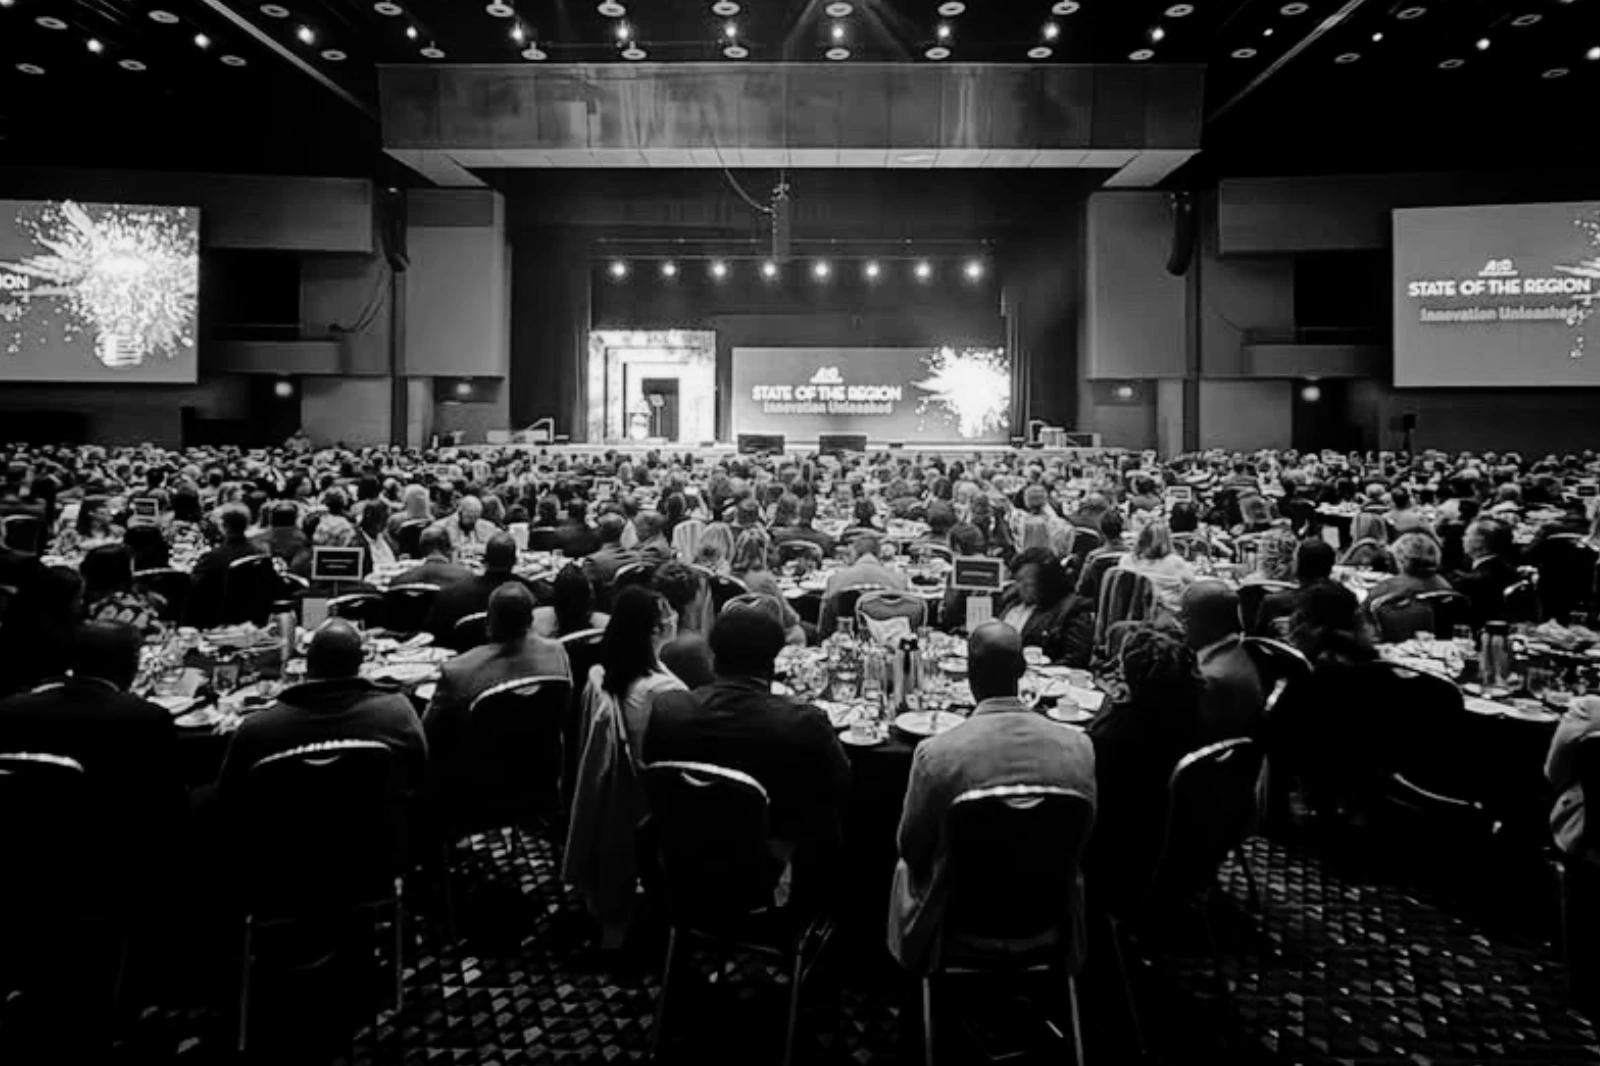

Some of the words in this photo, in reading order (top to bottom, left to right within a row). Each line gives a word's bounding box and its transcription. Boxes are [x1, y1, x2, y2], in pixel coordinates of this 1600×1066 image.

[1408, 281, 1456, 297] STATE
[1459, 280, 1485, 295] OF
[1487, 279, 1521, 294] THE
[1524, 278, 1591, 294] REGION
[752, 385, 792, 400] STATE
[795, 385, 816, 400] OF
[818, 385, 845, 400] THE
[848, 385, 902, 401] REGION
